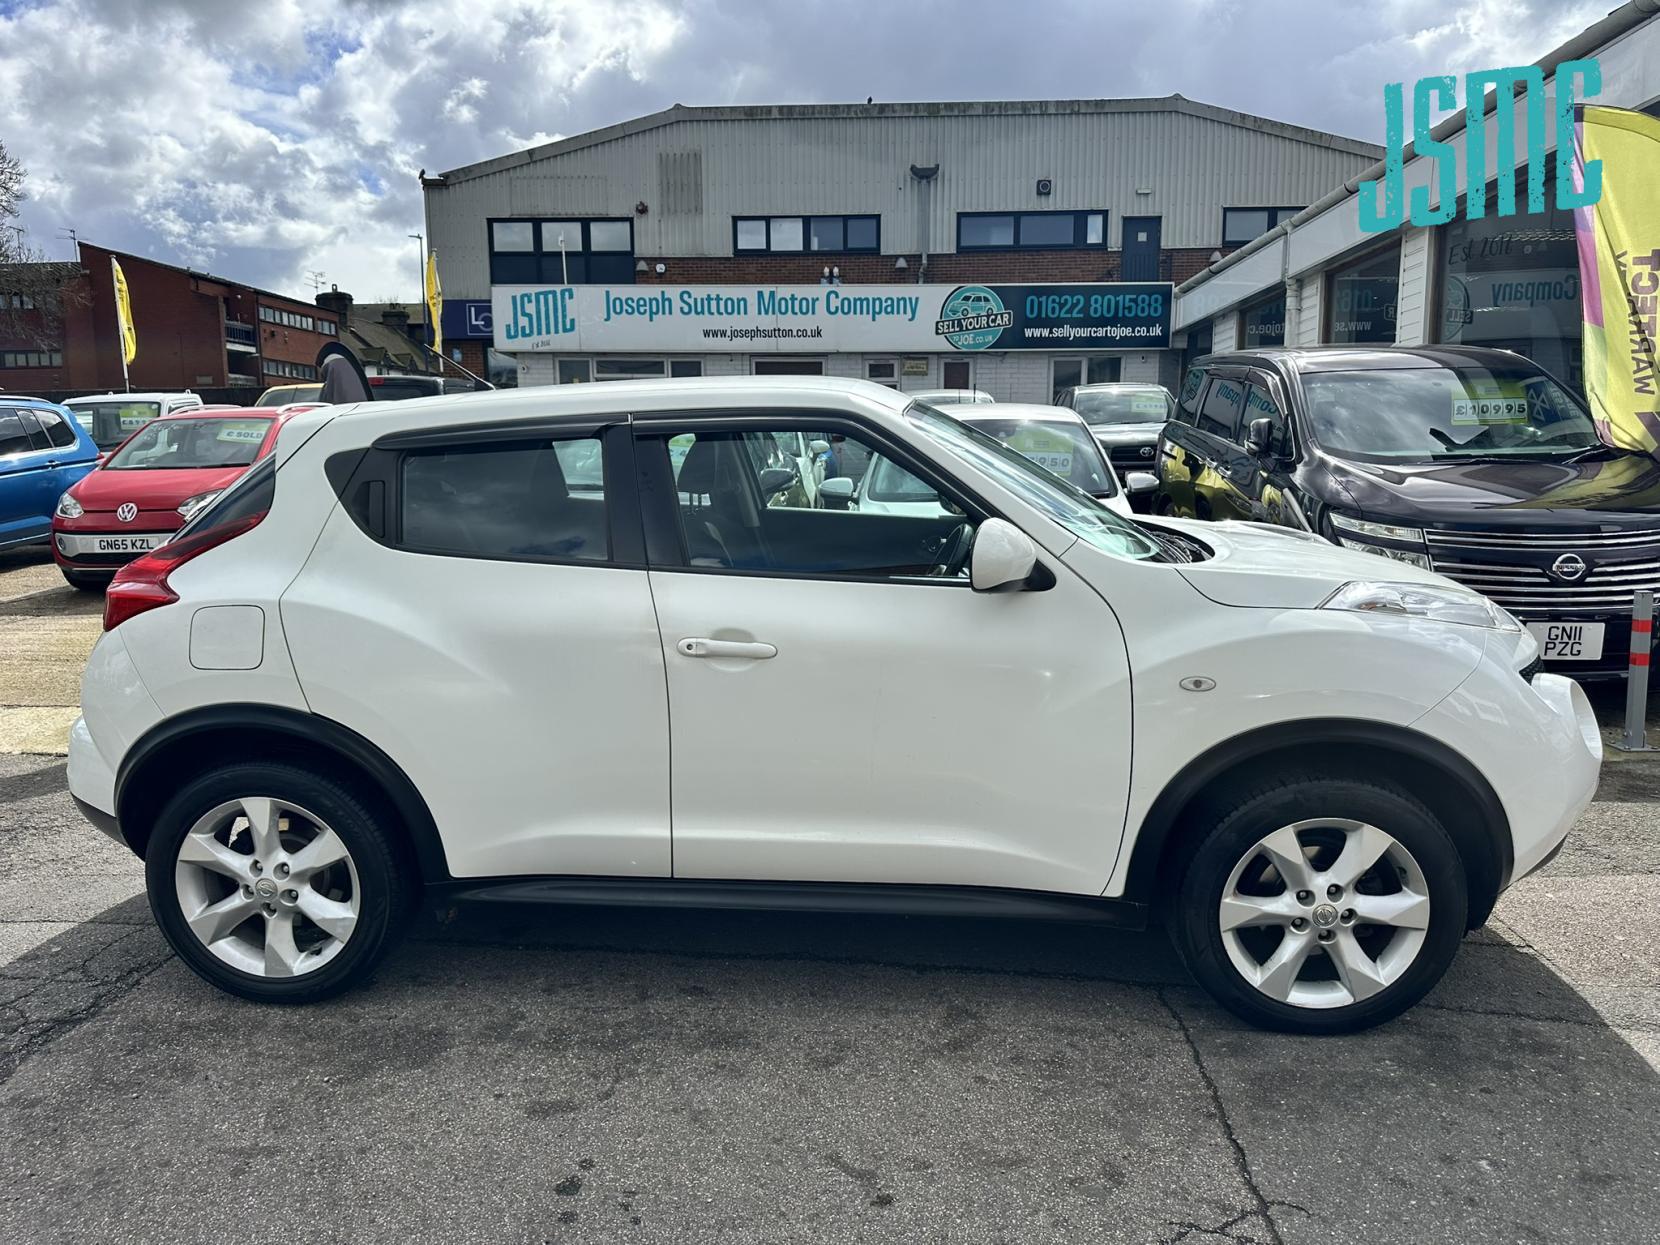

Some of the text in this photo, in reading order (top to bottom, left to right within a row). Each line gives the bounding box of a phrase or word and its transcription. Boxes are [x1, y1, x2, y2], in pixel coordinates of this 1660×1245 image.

[505, 288, 575, 339] JSMC
[604, 290, 919, 322] Joseph Sutton Motor Company
[1025, 294, 1162, 318] 01622 801588
[938, 313, 1009, 333] SELL YOUR CAR
[702, 325, 822, 341] www.josephsutton.co.uk
[958, 333, 975, 345] JOE
[1024, 324, 1162, 340] www.sellyourcartojoe.co.uk
[1455, 403, 1526, 416] £10995
[99, 539, 154, 550] GN65 KZL
[1544, 641, 1582, 656] PZG
